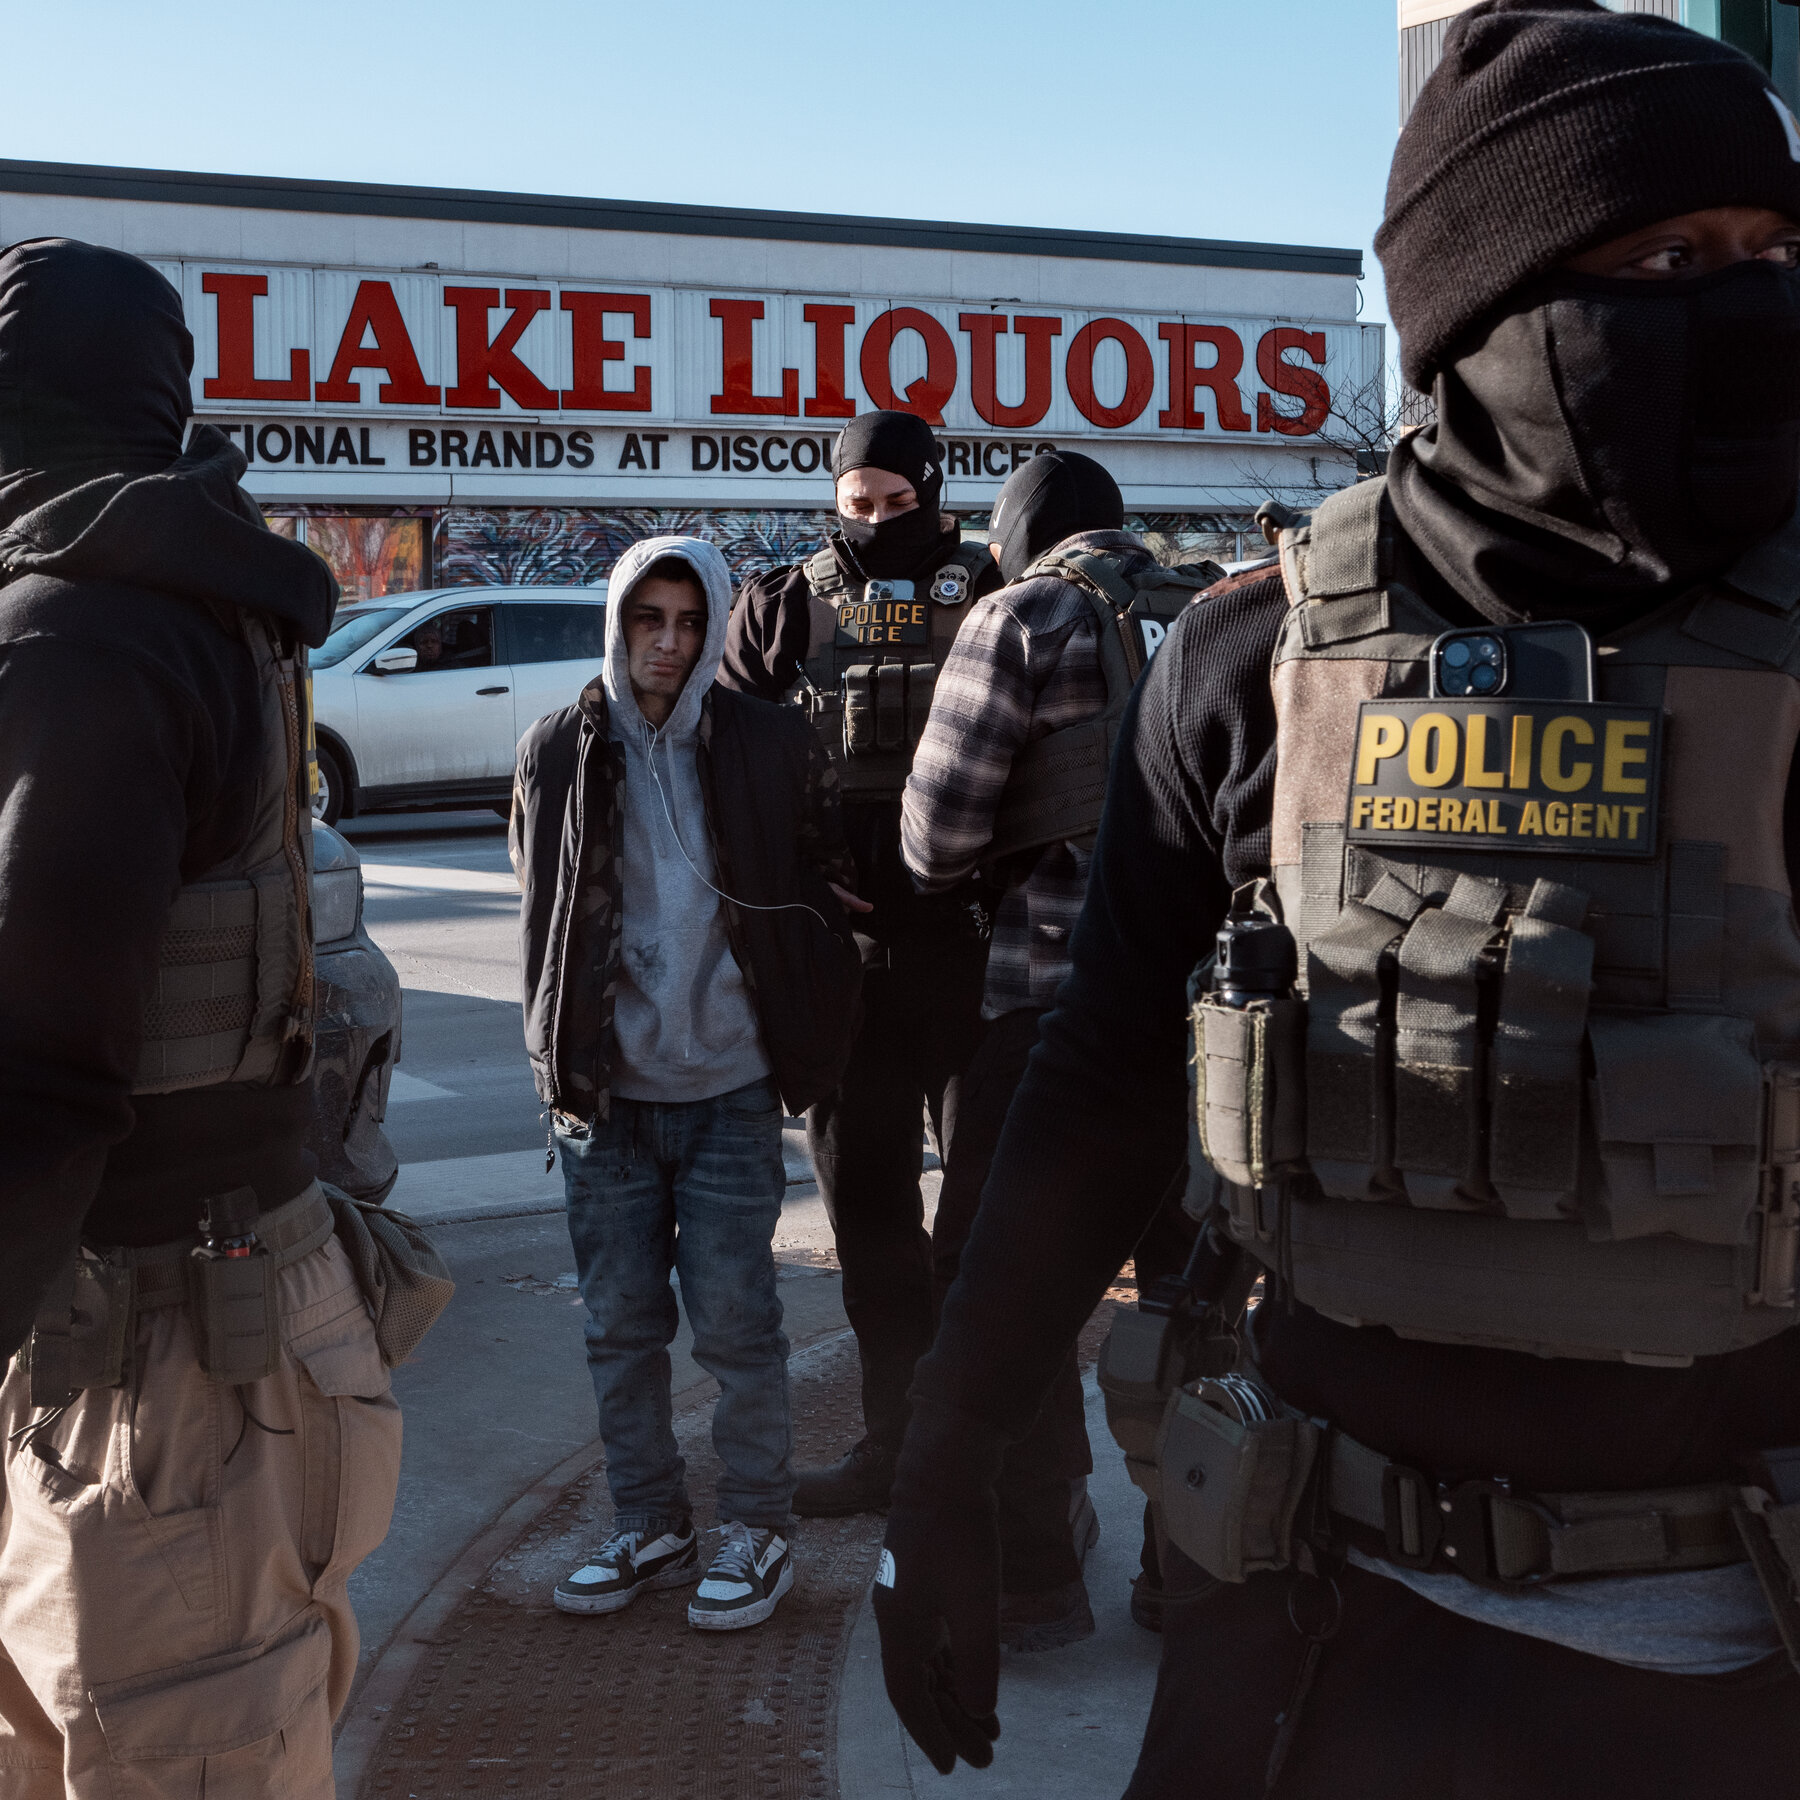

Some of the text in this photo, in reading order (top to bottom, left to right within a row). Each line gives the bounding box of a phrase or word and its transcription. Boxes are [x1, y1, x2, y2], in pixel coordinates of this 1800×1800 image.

[202, 272, 1332, 437] LAKE LIQUORS
[408, 428, 594, 469] BRANDS
[618, 433, 669, 470] AT
[840, 602, 925, 626] POLICE
[858, 625, 902, 643] ICE
[1355, 712, 1651, 794] POLICE
[1351, 795, 1645, 839] FEDERAL AGENT
